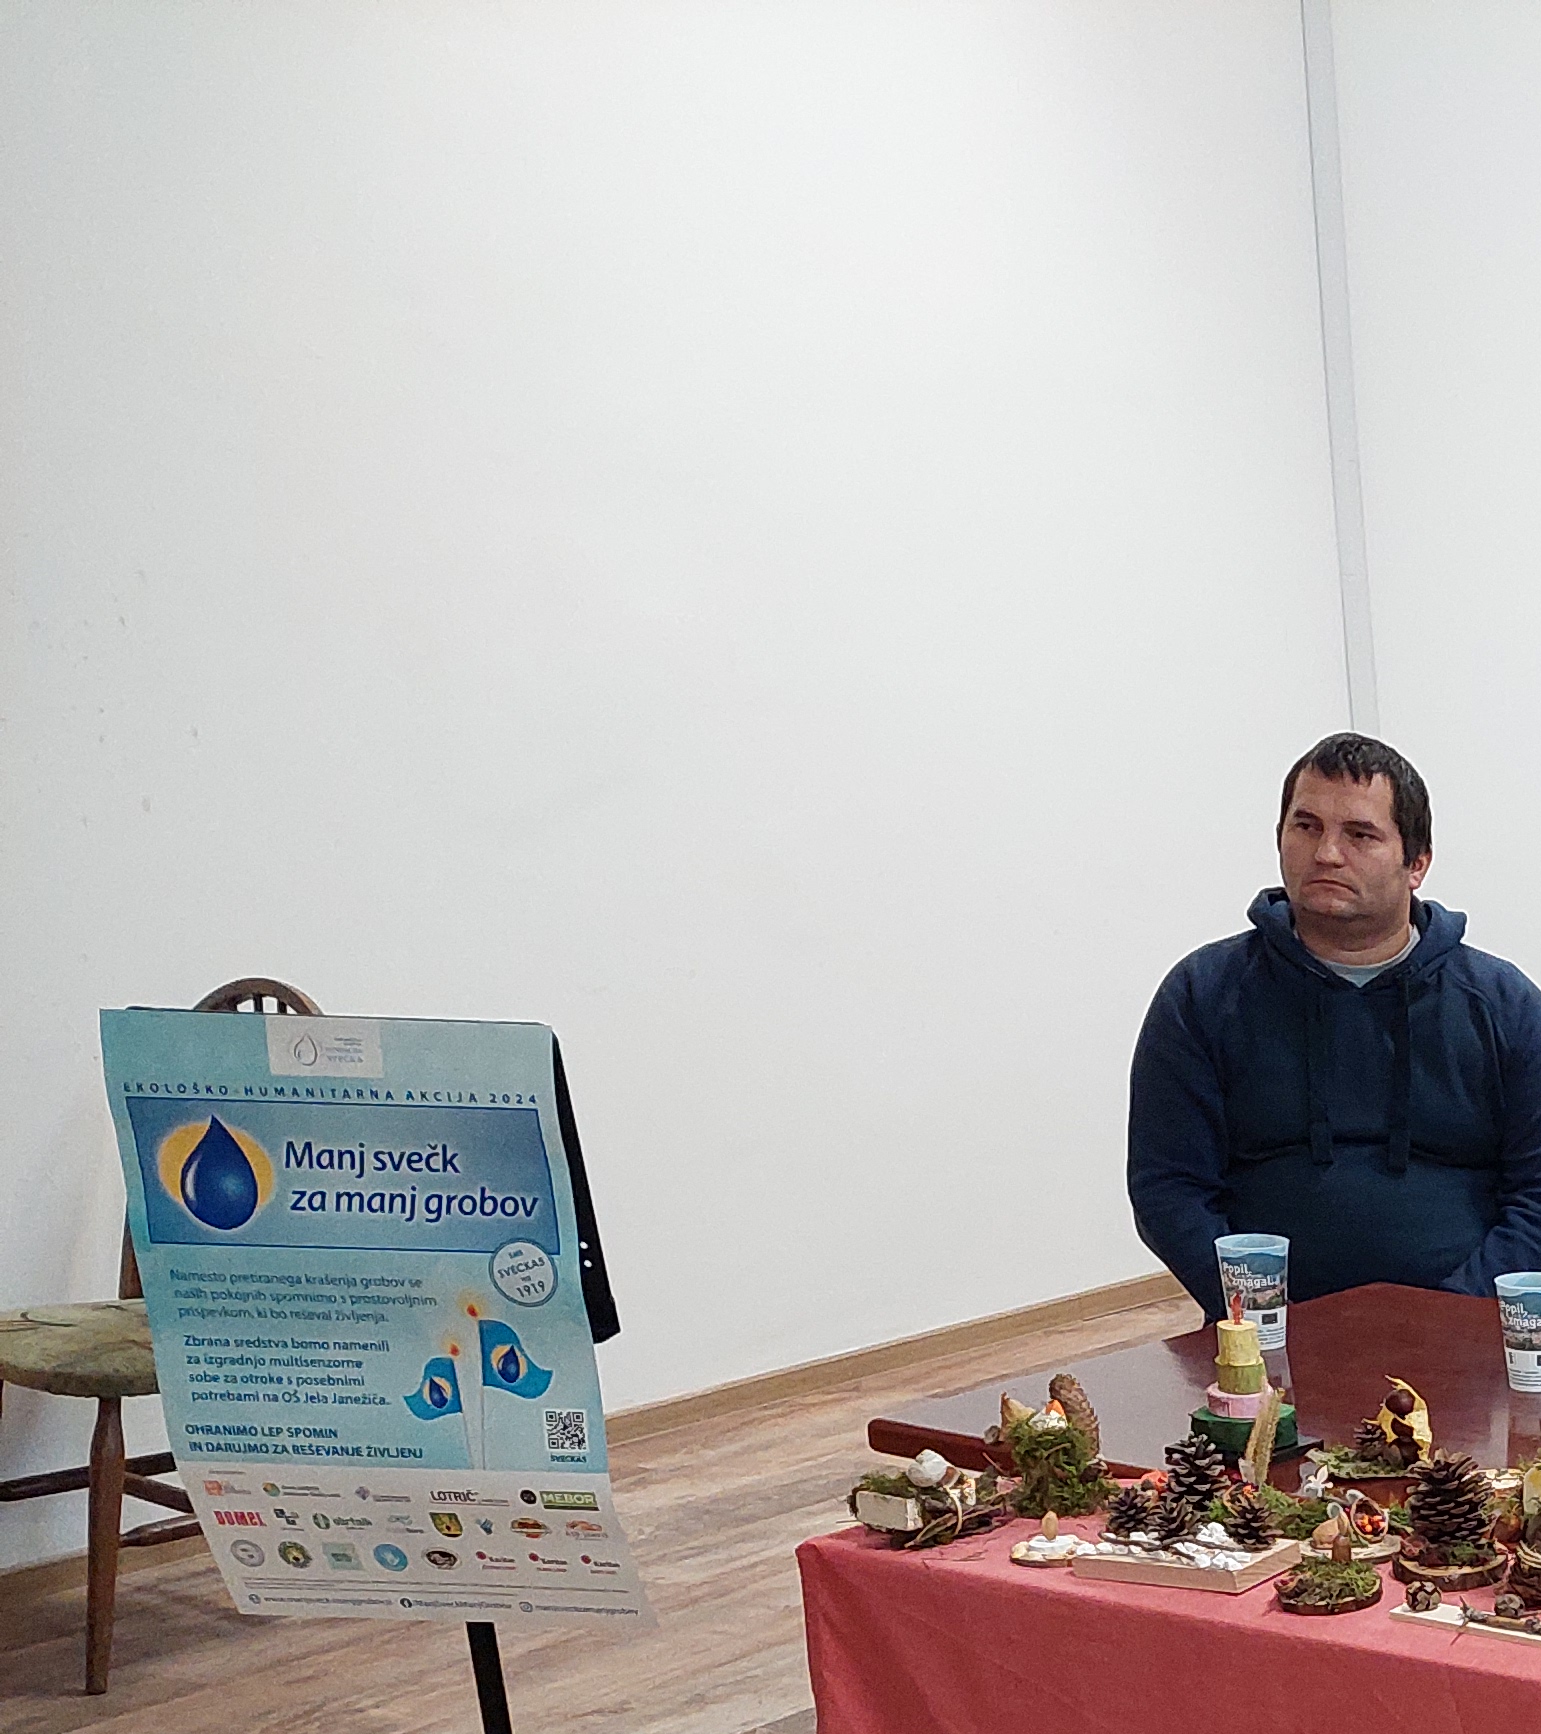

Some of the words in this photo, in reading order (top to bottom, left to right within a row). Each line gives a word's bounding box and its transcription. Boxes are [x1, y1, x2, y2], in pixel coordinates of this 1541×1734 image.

[405, 1090, 479, 1104] AKCIJA
[489, 1092, 537, 1105] 2024
[284, 1141, 366, 1179] Manj
[372, 1142, 461, 1174] svečk
[290, 1189, 328, 1212] za
[334, 1185, 418, 1222] manj
[424, 1186, 539, 1223] grobov
[169, 1269, 227, 1282] Namesto
[360, 1275, 405, 1290] grobov
[516, 1280, 545, 1298] 1919
[233, 1335, 289, 1349] sredstva
[290, 1337, 330, 1350] bomo
[332, 1339, 390, 1353] namenili
[185, 1355, 201, 1365] za
[203, 1352, 266, 1370] izgradnjo
[188, 1370, 221, 1383] sobe
[223, 1374, 238, 1384] za
[240, 1372, 284, 1385] otroke
[295, 1373, 366, 1388] posebnimi
[191, 1389, 260, 1403] potrebami
[262, 1393, 279, 1403] na
[303, 1391, 329, 1404] Jela
[184, 1424, 259, 1437] OHRANIMO
[260, 1425, 284, 1438] LEP
[286, 1426, 339, 1439] SPOMIN
[188, 1441, 204, 1453] IN
[205, 1441, 270, 1455] DARUJMO
[272, 1443, 290, 1455] ZA
[541, 1492, 597, 1505] MEBOR
